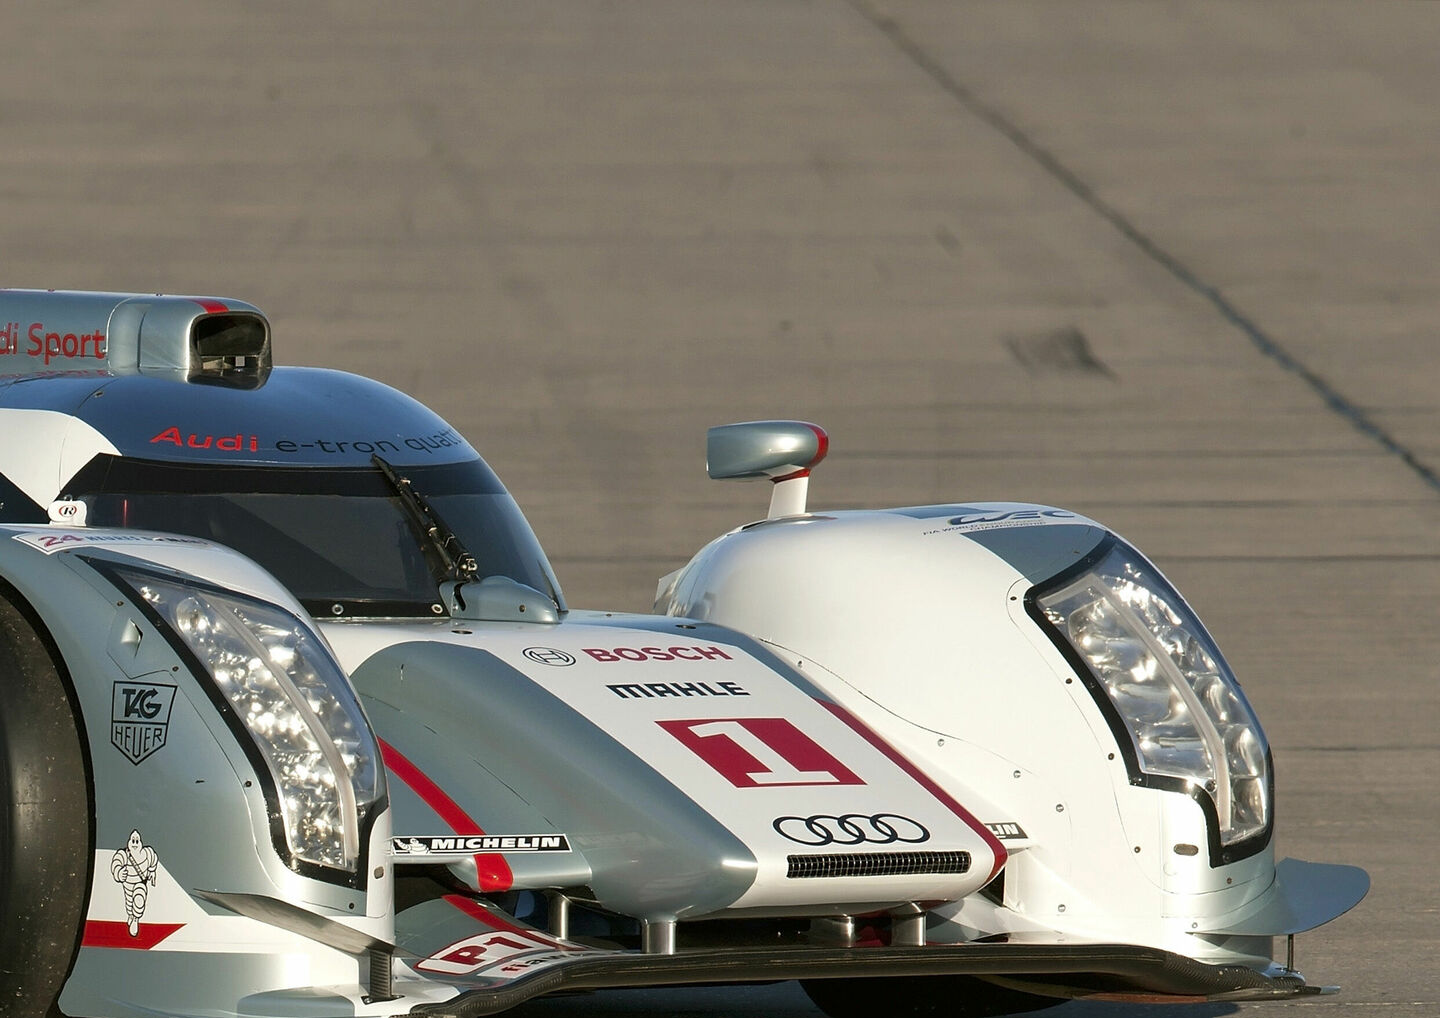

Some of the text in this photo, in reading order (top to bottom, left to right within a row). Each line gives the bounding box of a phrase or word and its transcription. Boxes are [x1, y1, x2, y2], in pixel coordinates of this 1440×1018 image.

[27, 322, 108, 365] Sport
[150, 426, 257, 452] Audi
[276, 438, 400, 454] e-tron
[581, 646, 734, 663] BOSCH
[121, 687, 163, 719] TAG
[605, 682, 751, 698] MAHLE
[115, 726, 163, 754] HEUER
[686, 720, 841, 784] 1
[431, 834, 562, 852] MICHELIN
[440, 936, 533, 965] P1
